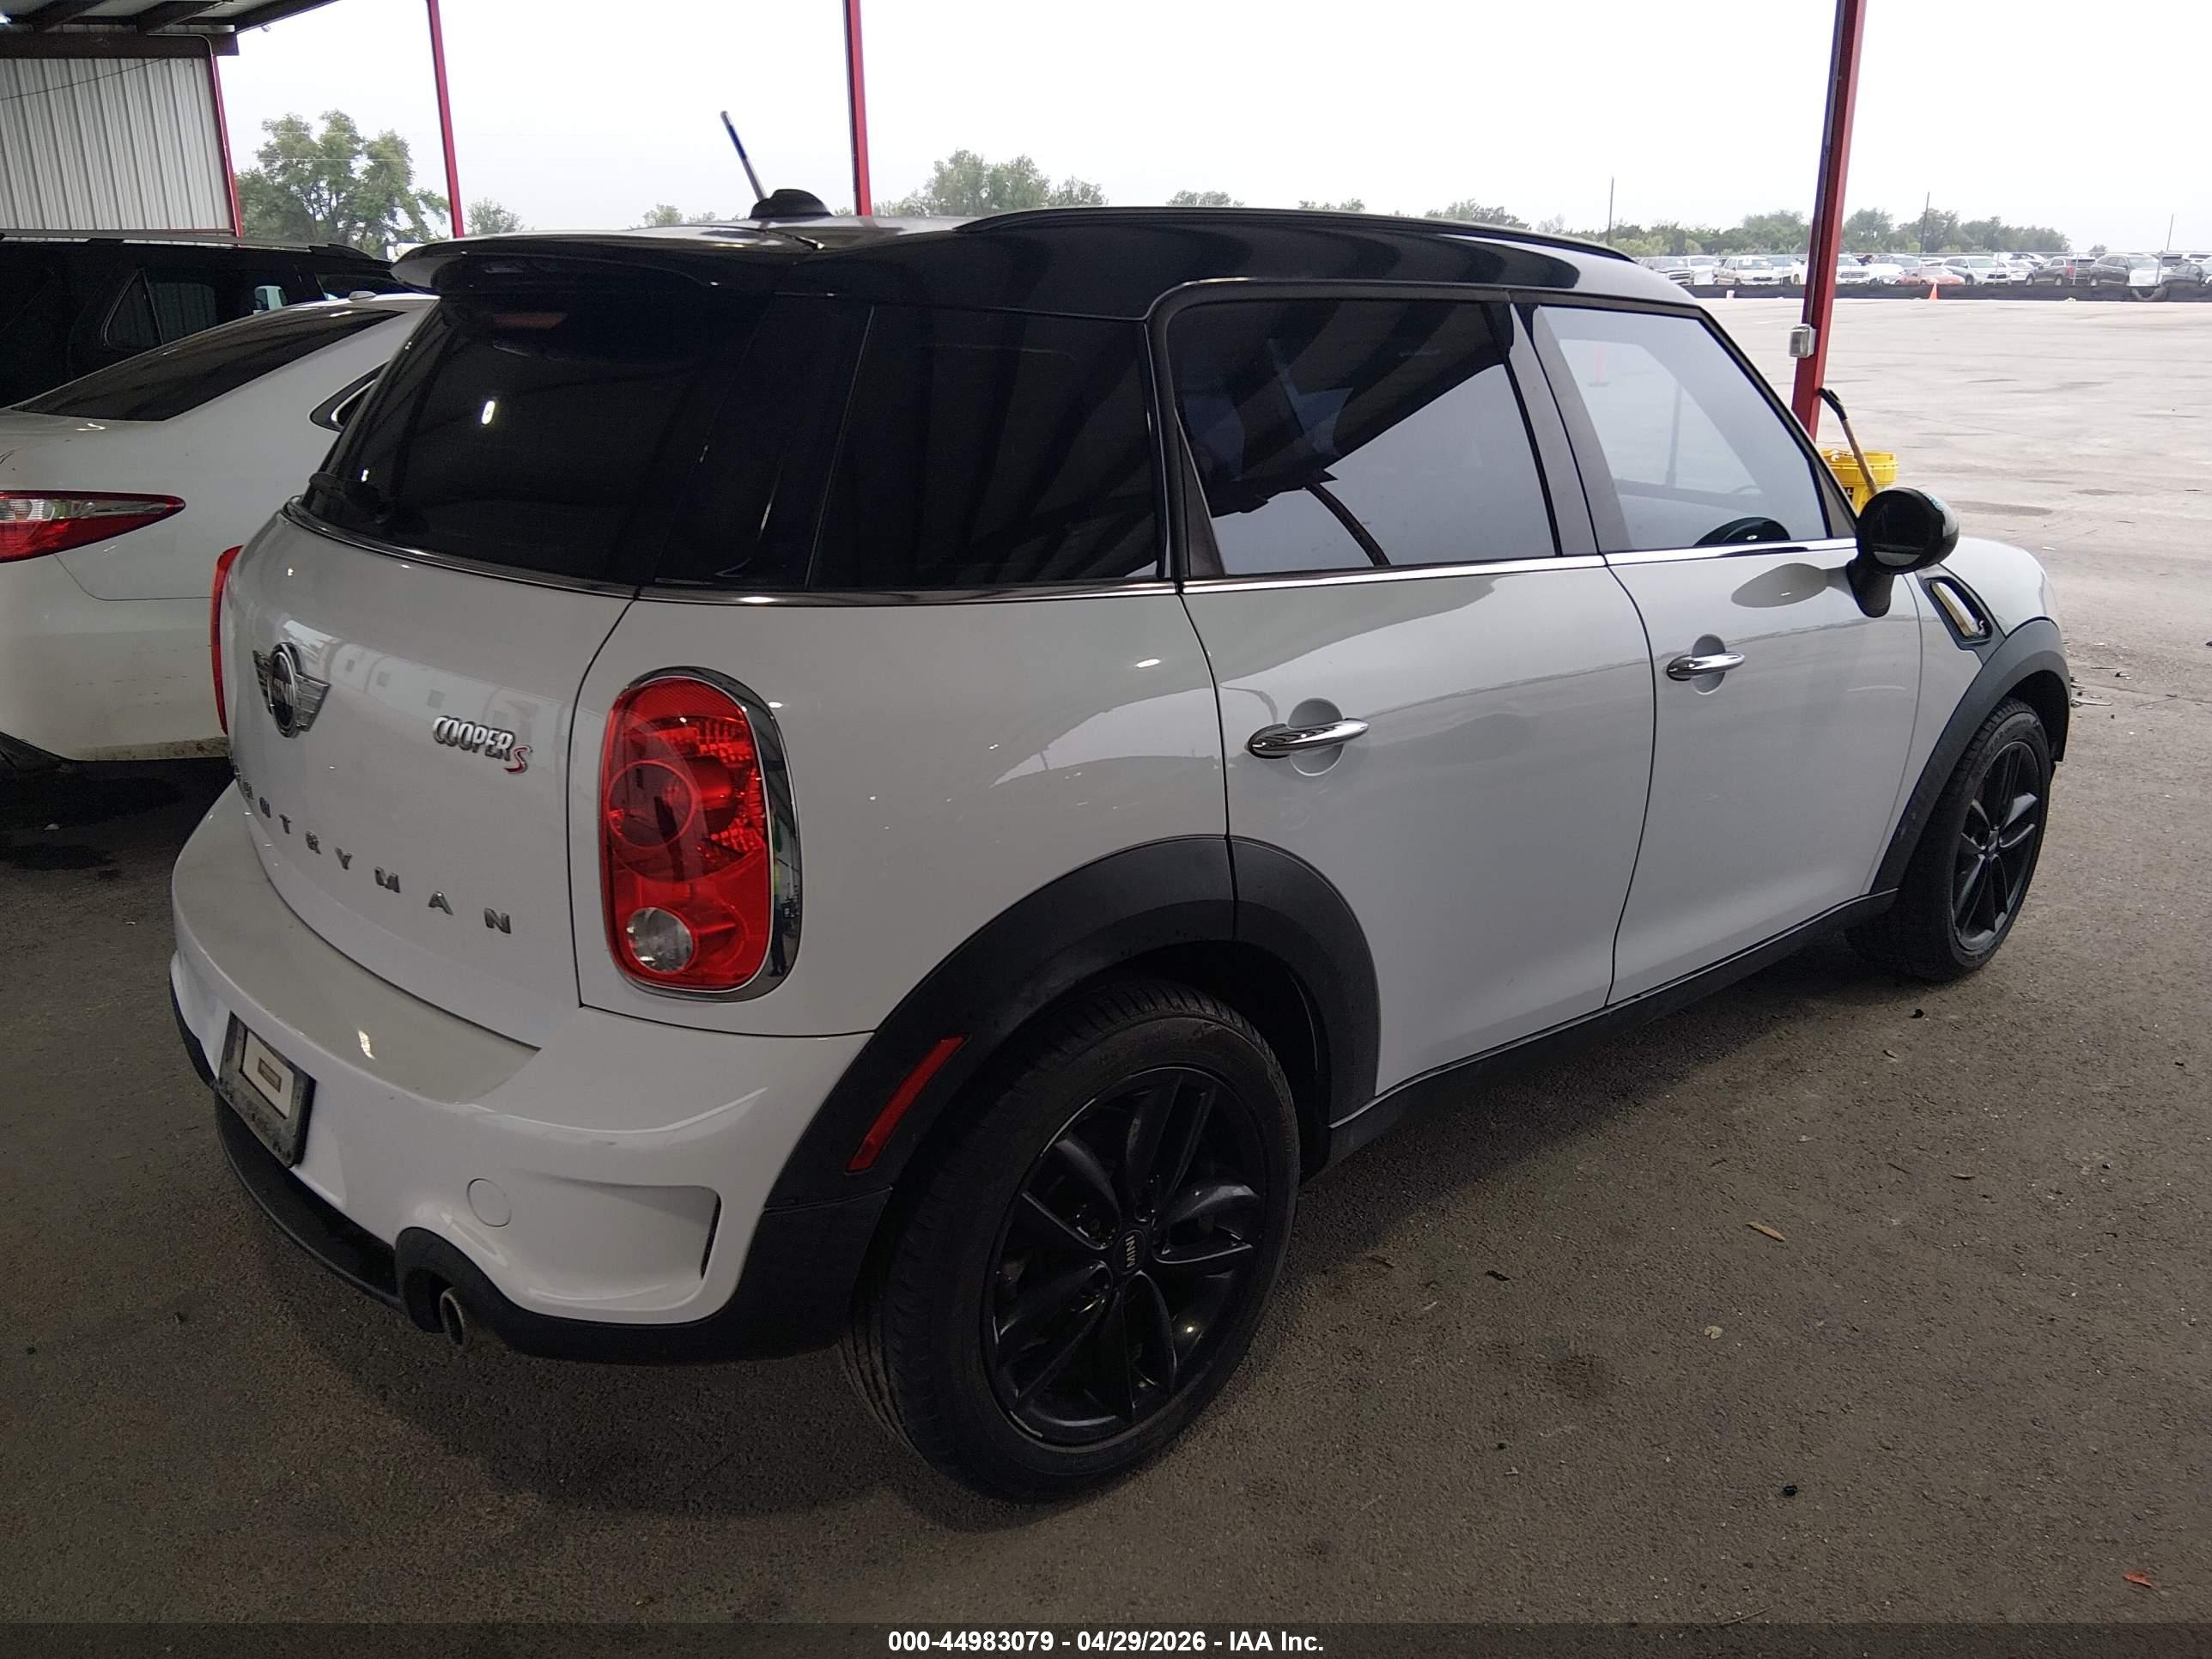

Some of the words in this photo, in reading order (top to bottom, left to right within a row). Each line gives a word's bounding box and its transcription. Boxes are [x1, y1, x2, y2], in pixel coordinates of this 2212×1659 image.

[432, 715, 515, 762] COOPER
[504, 744, 532, 773] S
[1125, 1235, 1136, 1268] MINI
